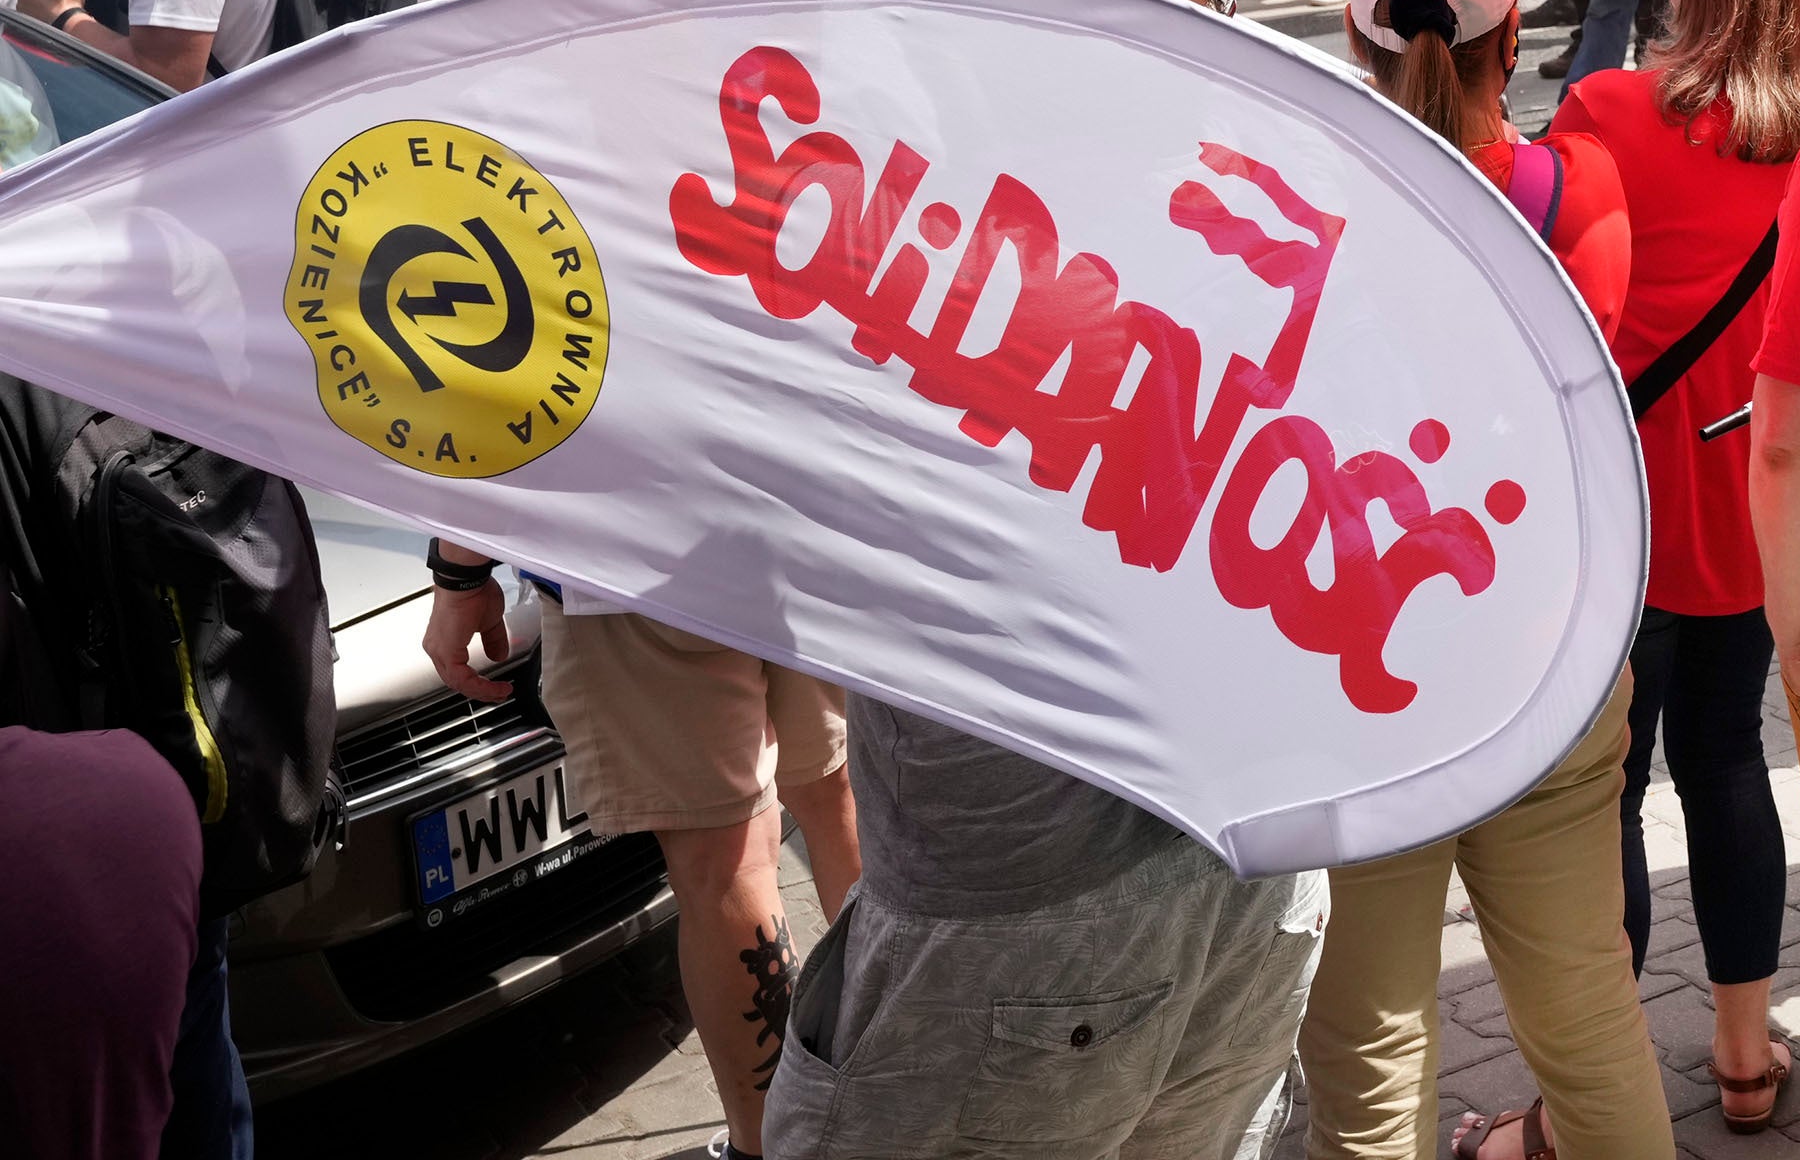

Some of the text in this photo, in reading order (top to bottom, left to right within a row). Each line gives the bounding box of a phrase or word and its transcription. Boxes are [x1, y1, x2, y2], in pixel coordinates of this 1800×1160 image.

[407, 136, 593, 445] ELEKTROWNIA
[385, 418, 478, 463] S.A.
[457, 766, 590, 875] WWL
[425, 865, 449, 888] PL
